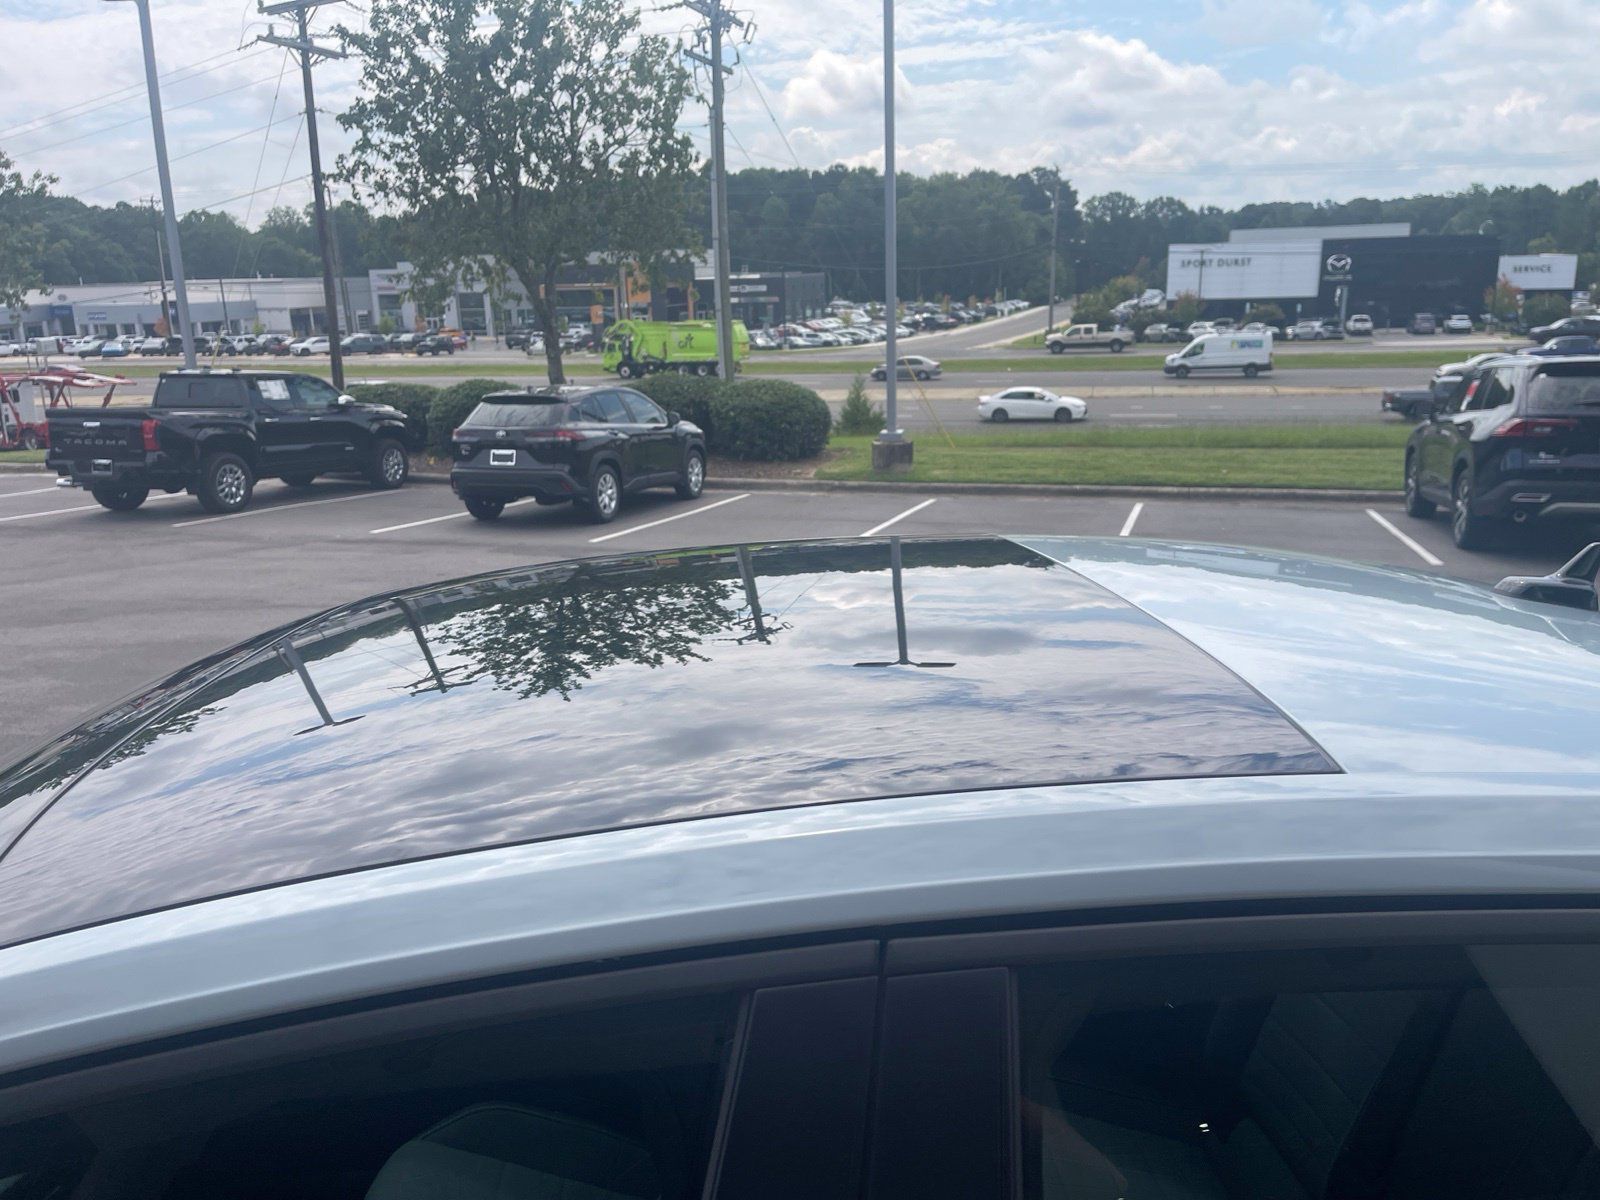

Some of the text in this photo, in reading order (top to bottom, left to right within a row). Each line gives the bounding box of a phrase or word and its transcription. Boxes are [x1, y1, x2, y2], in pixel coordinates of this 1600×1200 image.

[1217, 257, 1252, 267] DURST
[1513, 264, 1552, 273] SERVICE
[63, 438, 127, 446] TACOMA
